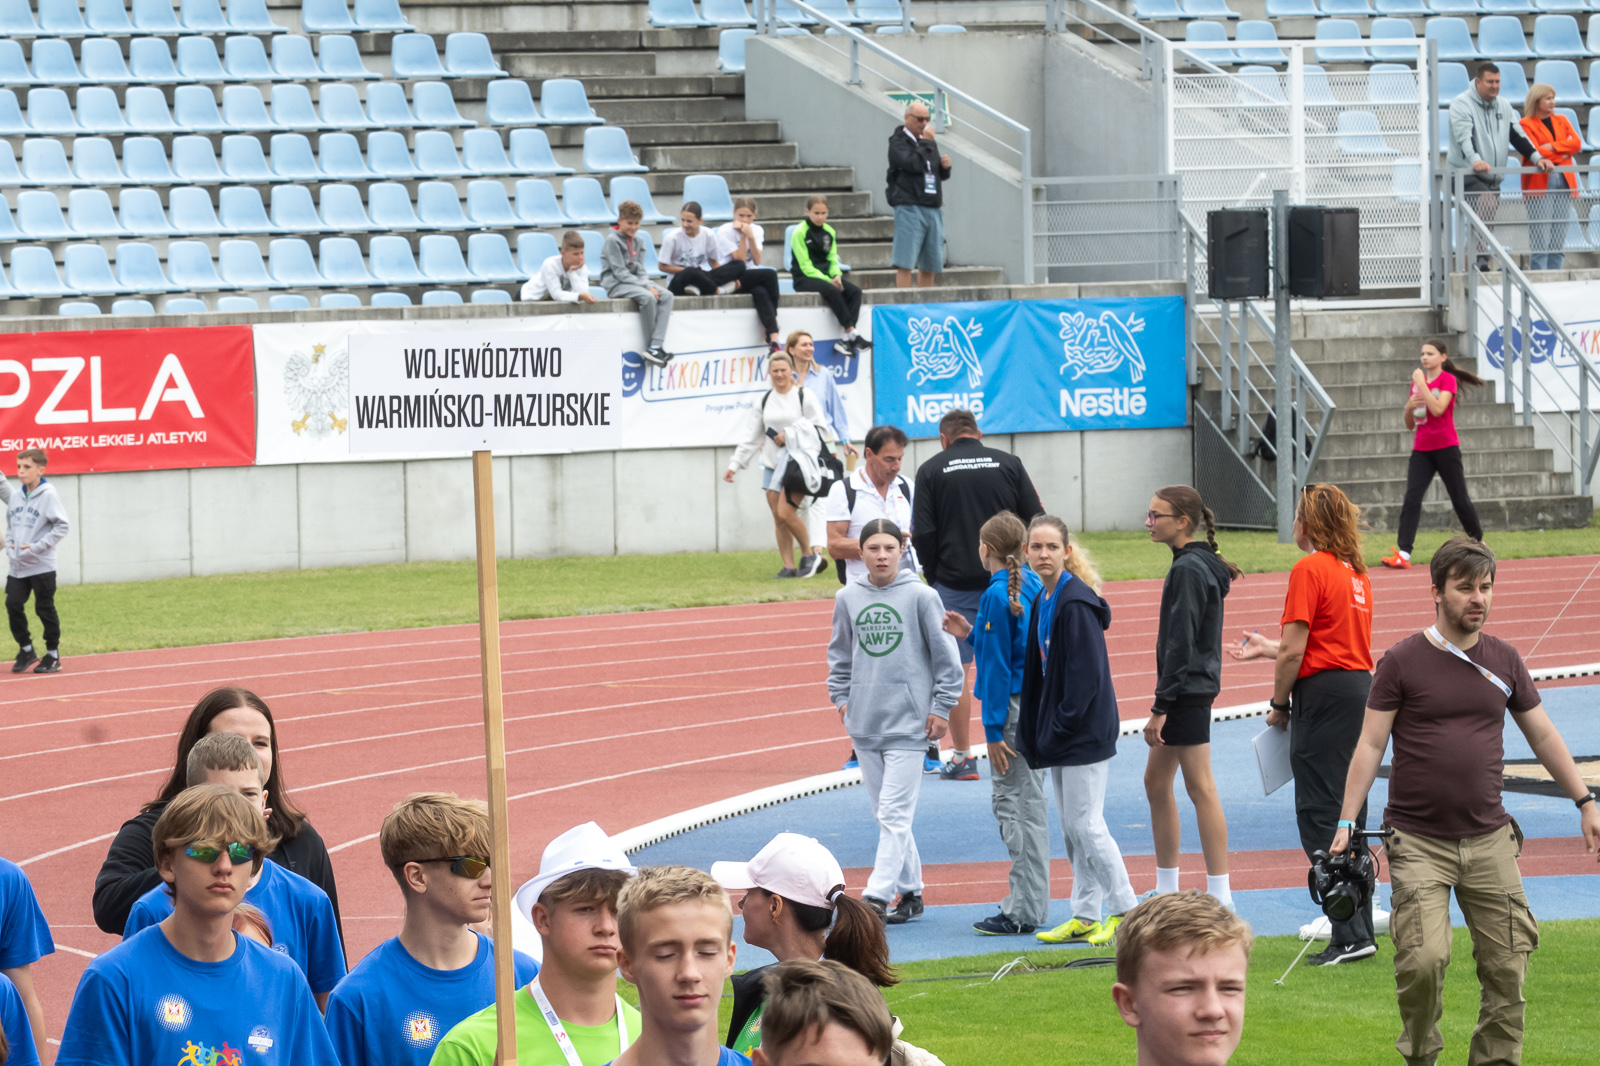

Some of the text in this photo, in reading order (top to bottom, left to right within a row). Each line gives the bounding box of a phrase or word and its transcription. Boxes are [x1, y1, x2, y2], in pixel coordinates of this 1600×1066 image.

[403, 342, 562, 379] WOJEWÓDZTWO
[355, 388, 611, 429] WARMIŃSKO-MAZURSKIE
[1060, 386, 1147, 418] Nestlé
[26, 436, 89, 451] ZWIĄZEK
[91, 434, 144, 447] LEKKIEJ
[147, 431, 207, 445] ATLETYKI
[864, 611, 892, 625] AZS
[865, 632, 894, 645] AWF
